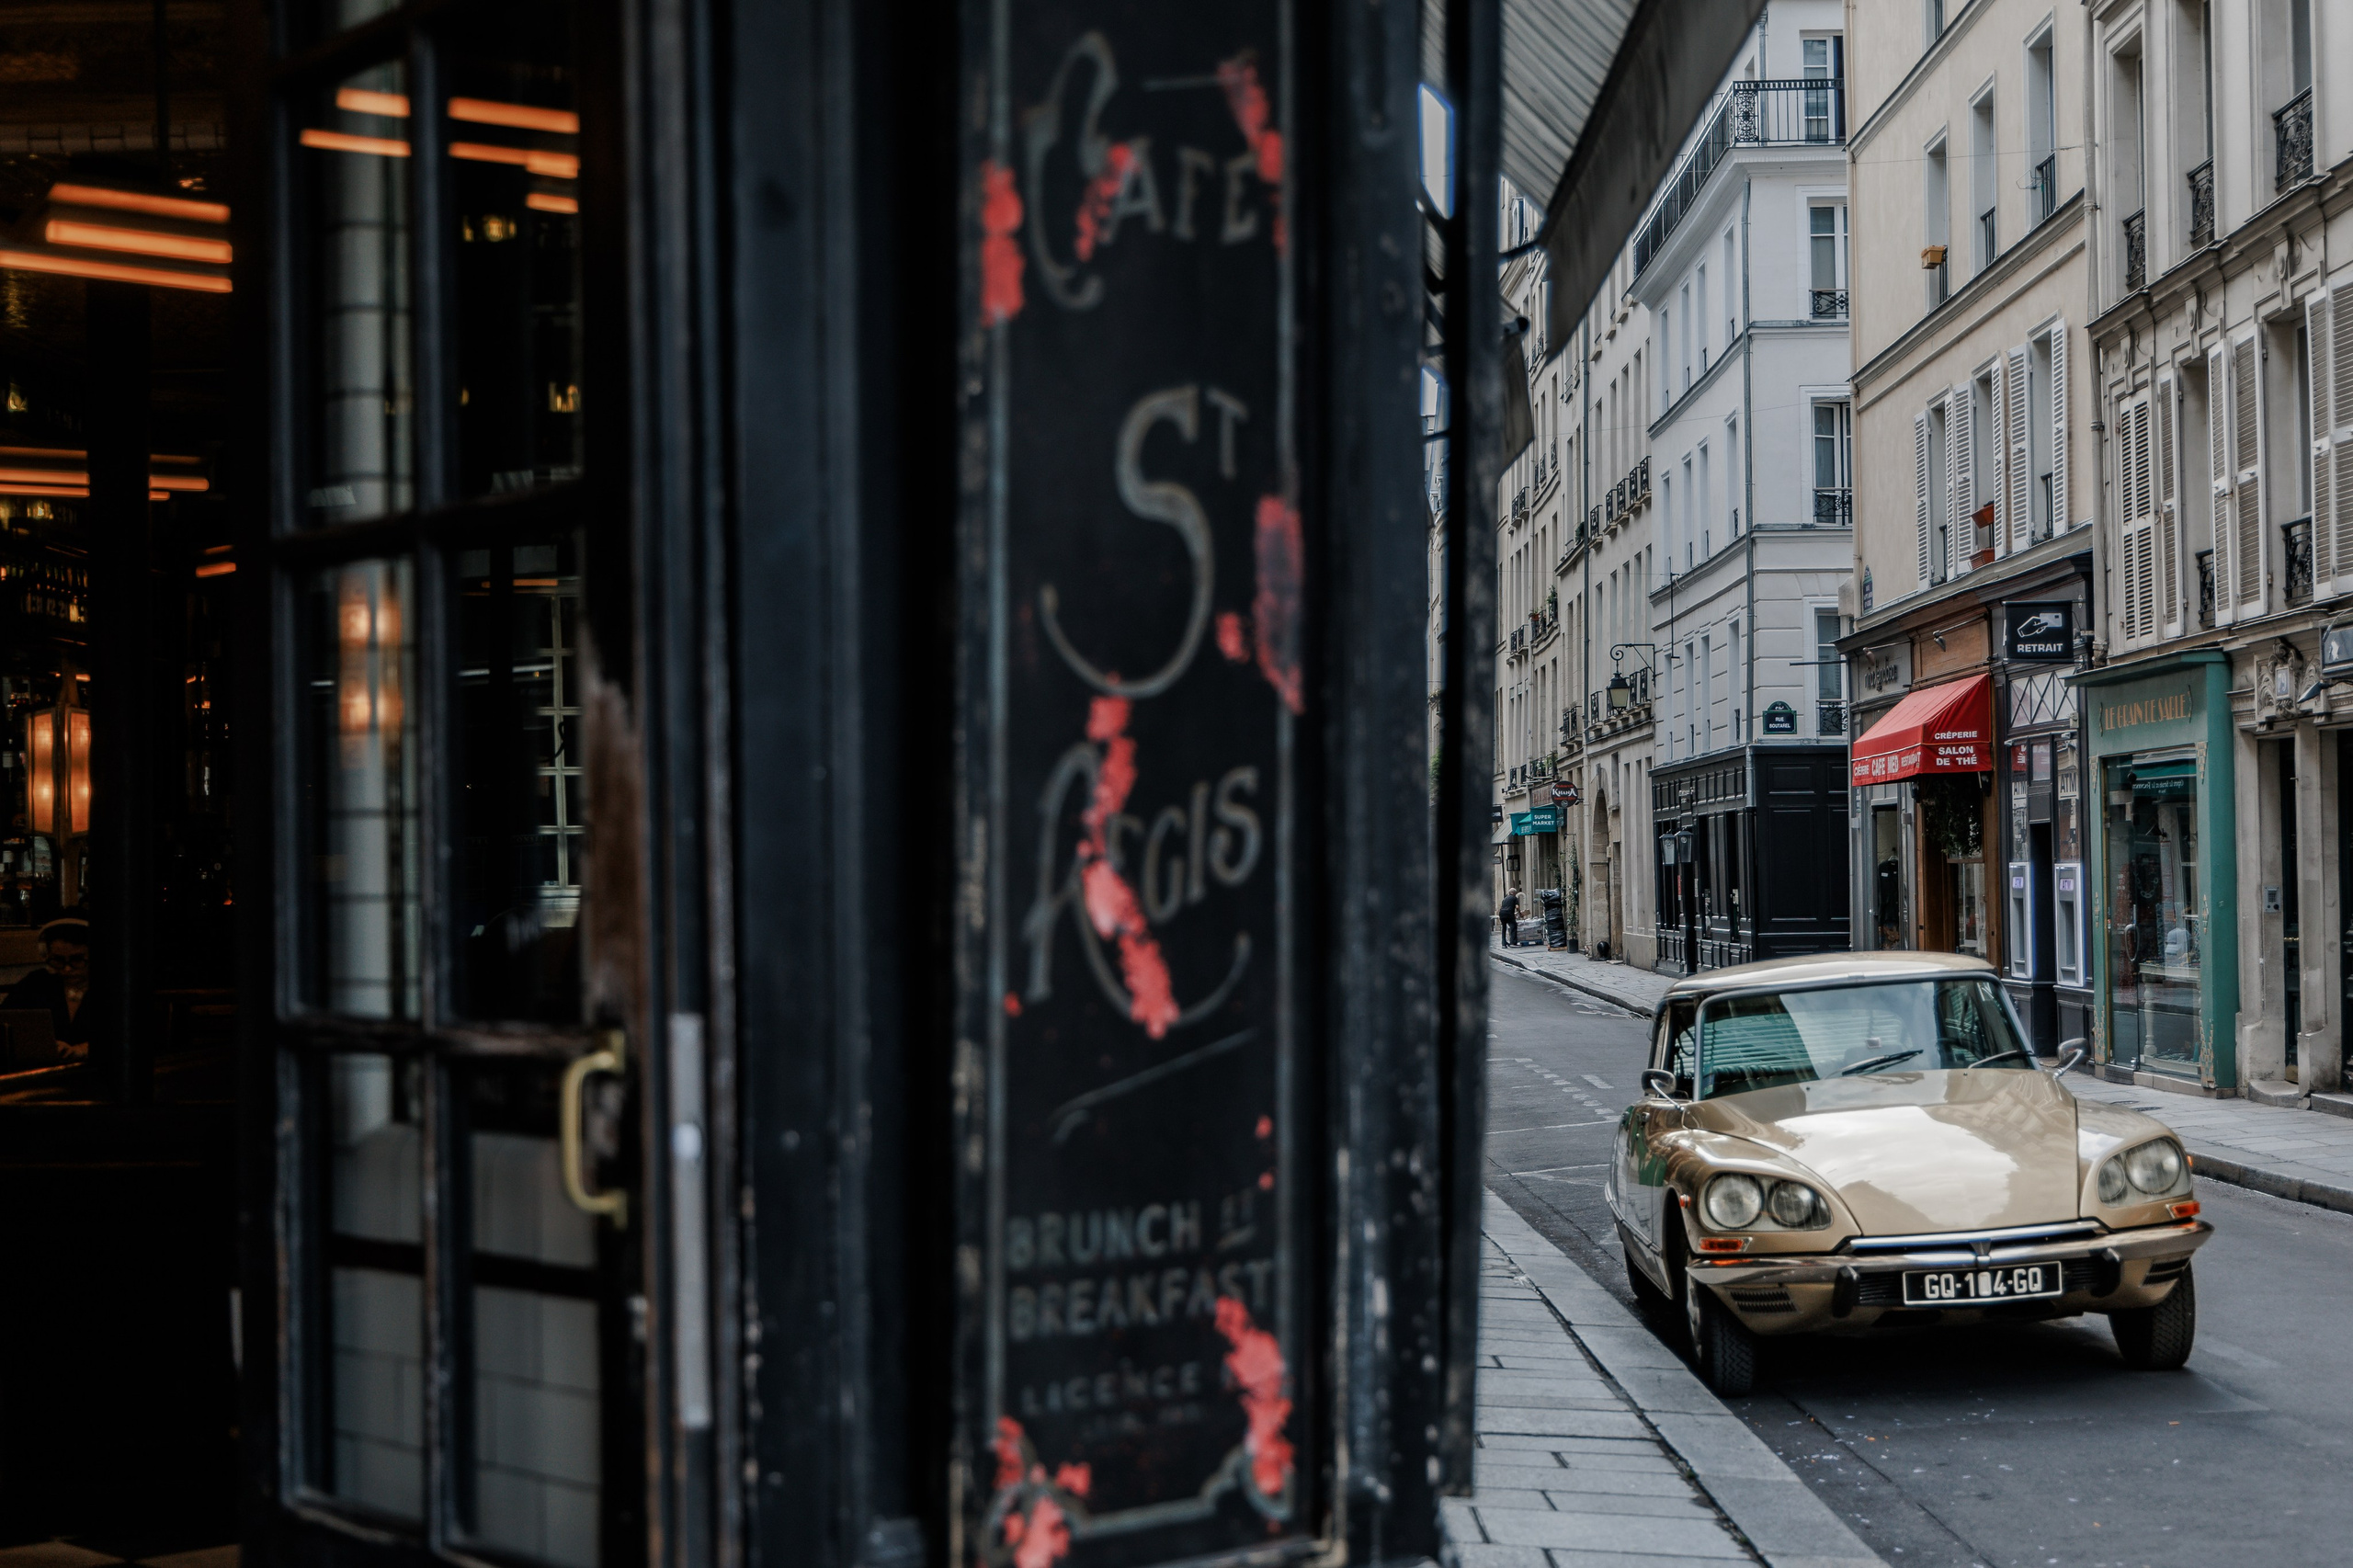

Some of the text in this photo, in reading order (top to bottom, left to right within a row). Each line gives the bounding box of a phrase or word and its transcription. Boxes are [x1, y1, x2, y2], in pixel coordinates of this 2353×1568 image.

[2017, 642, 2063, 653] RETRAIT
[2105, 707, 2115, 731] LE
[1934, 731, 1978, 740] CRÊPERIE
[1938, 745, 1974, 756] SALON
[1936, 754, 1978, 766] DE THÉ
[2059, 772, 2077, 793] ATM
[1006, 1199, 1202, 1269] BRUNCH
[1007, 1257, 1273, 1342] BREAKFAST
